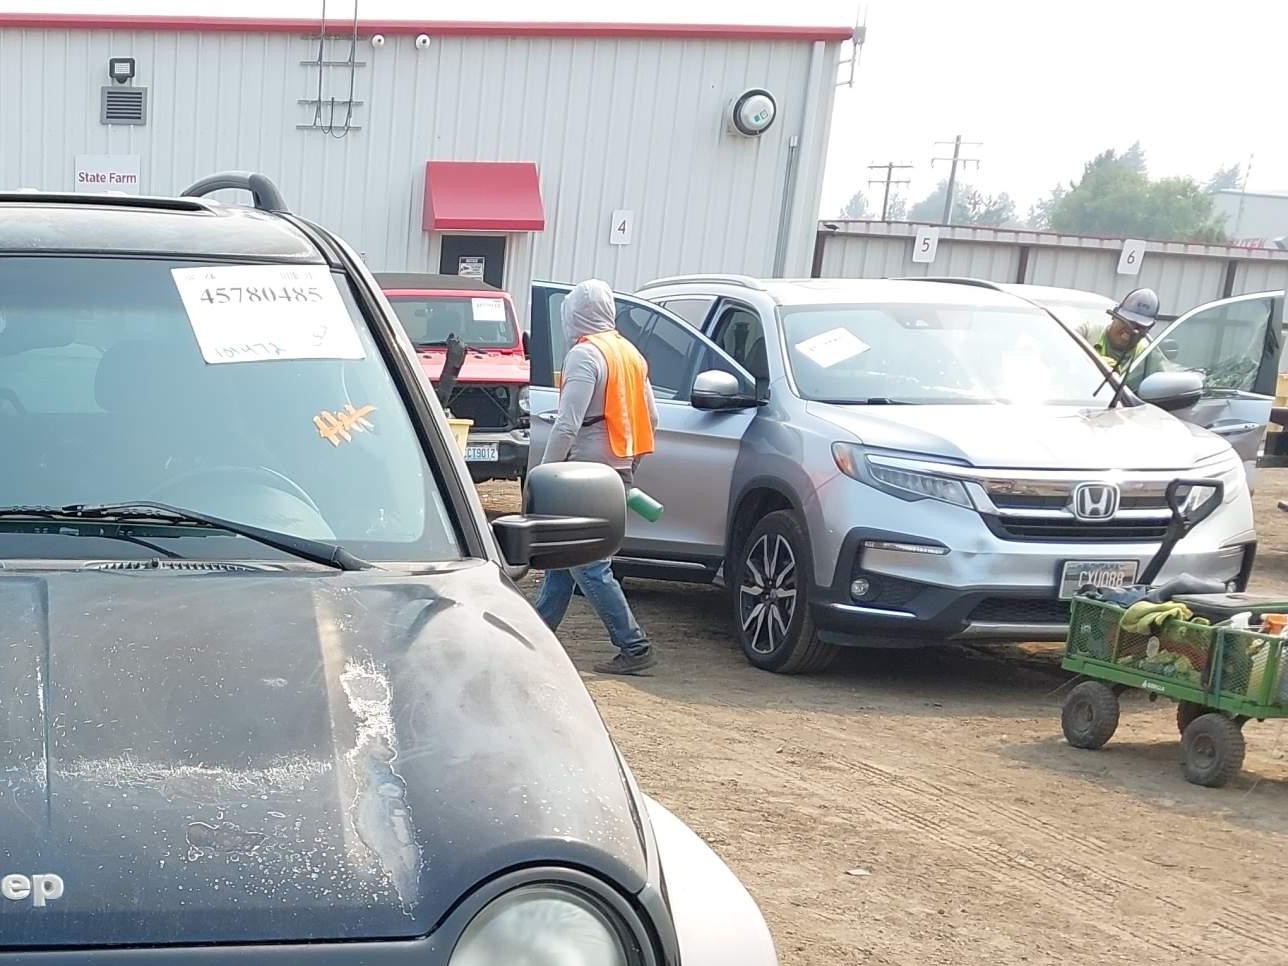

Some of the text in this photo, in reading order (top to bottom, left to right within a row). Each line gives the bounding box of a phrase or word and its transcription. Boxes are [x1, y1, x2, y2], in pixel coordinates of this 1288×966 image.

[78, 171, 137, 184] State Farm
[617, 219, 626, 235] 4
[921, 237, 931, 253] 5
[1127, 249, 1136, 264] 6
[200, 287, 324, 304] 45780485
[464, 447, 496, 459] CT9012
